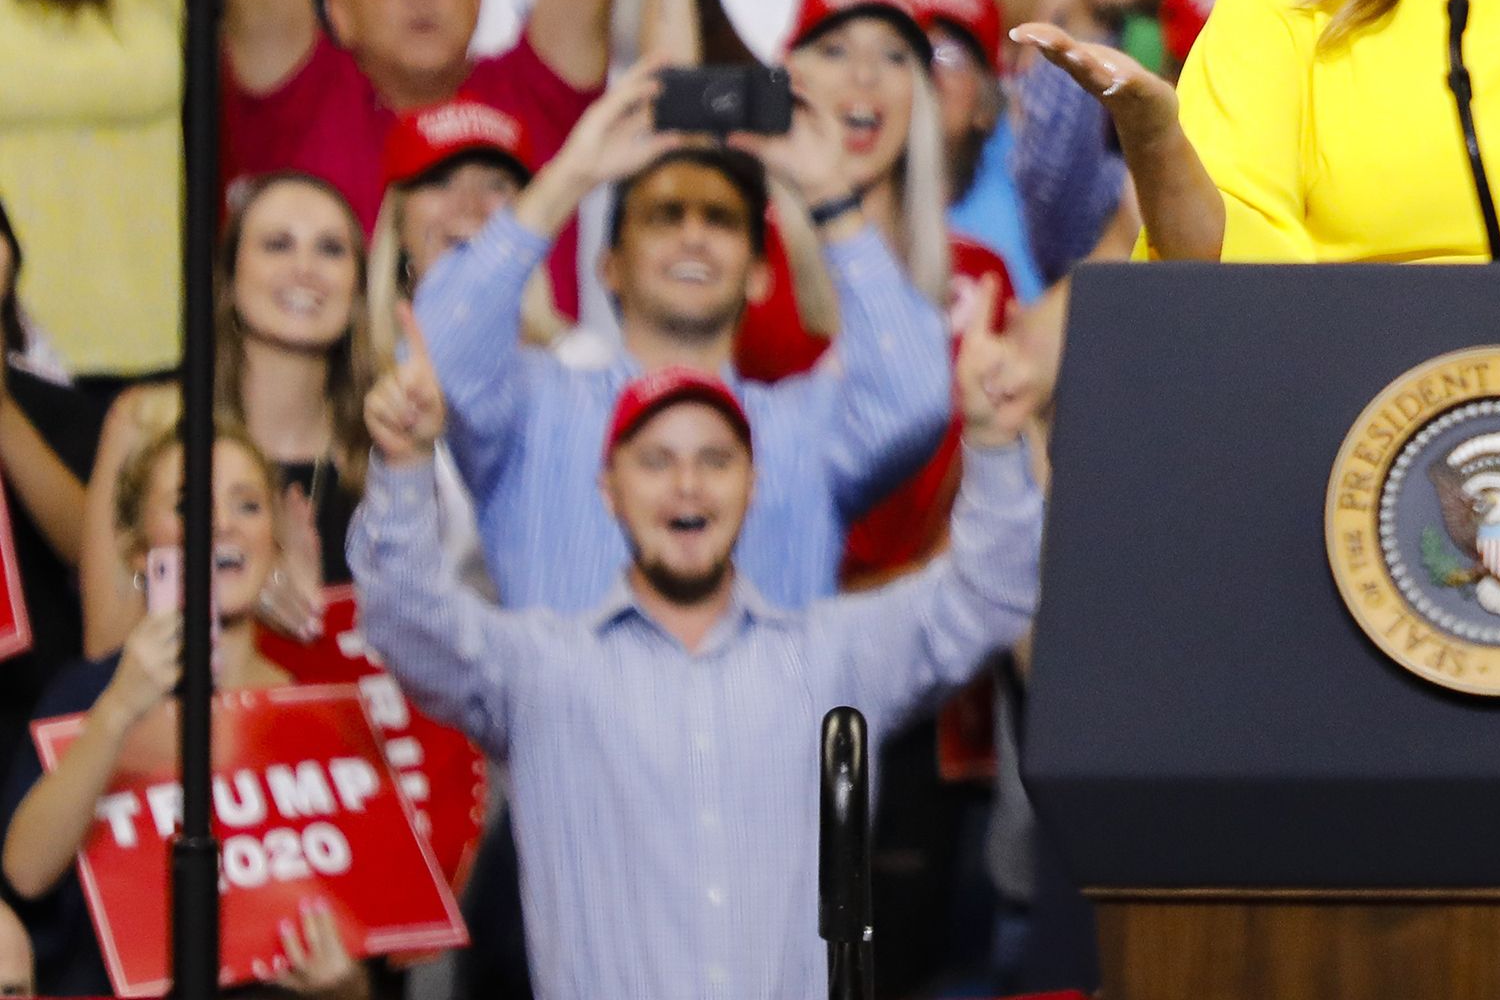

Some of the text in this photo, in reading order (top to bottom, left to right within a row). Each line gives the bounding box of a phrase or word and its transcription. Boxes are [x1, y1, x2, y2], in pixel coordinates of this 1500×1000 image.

[1339, 362, 1489, 512] PRESIDENT
[1385, 613, 1469, 677] SEAL
[217, 821, 353, 896] 020
